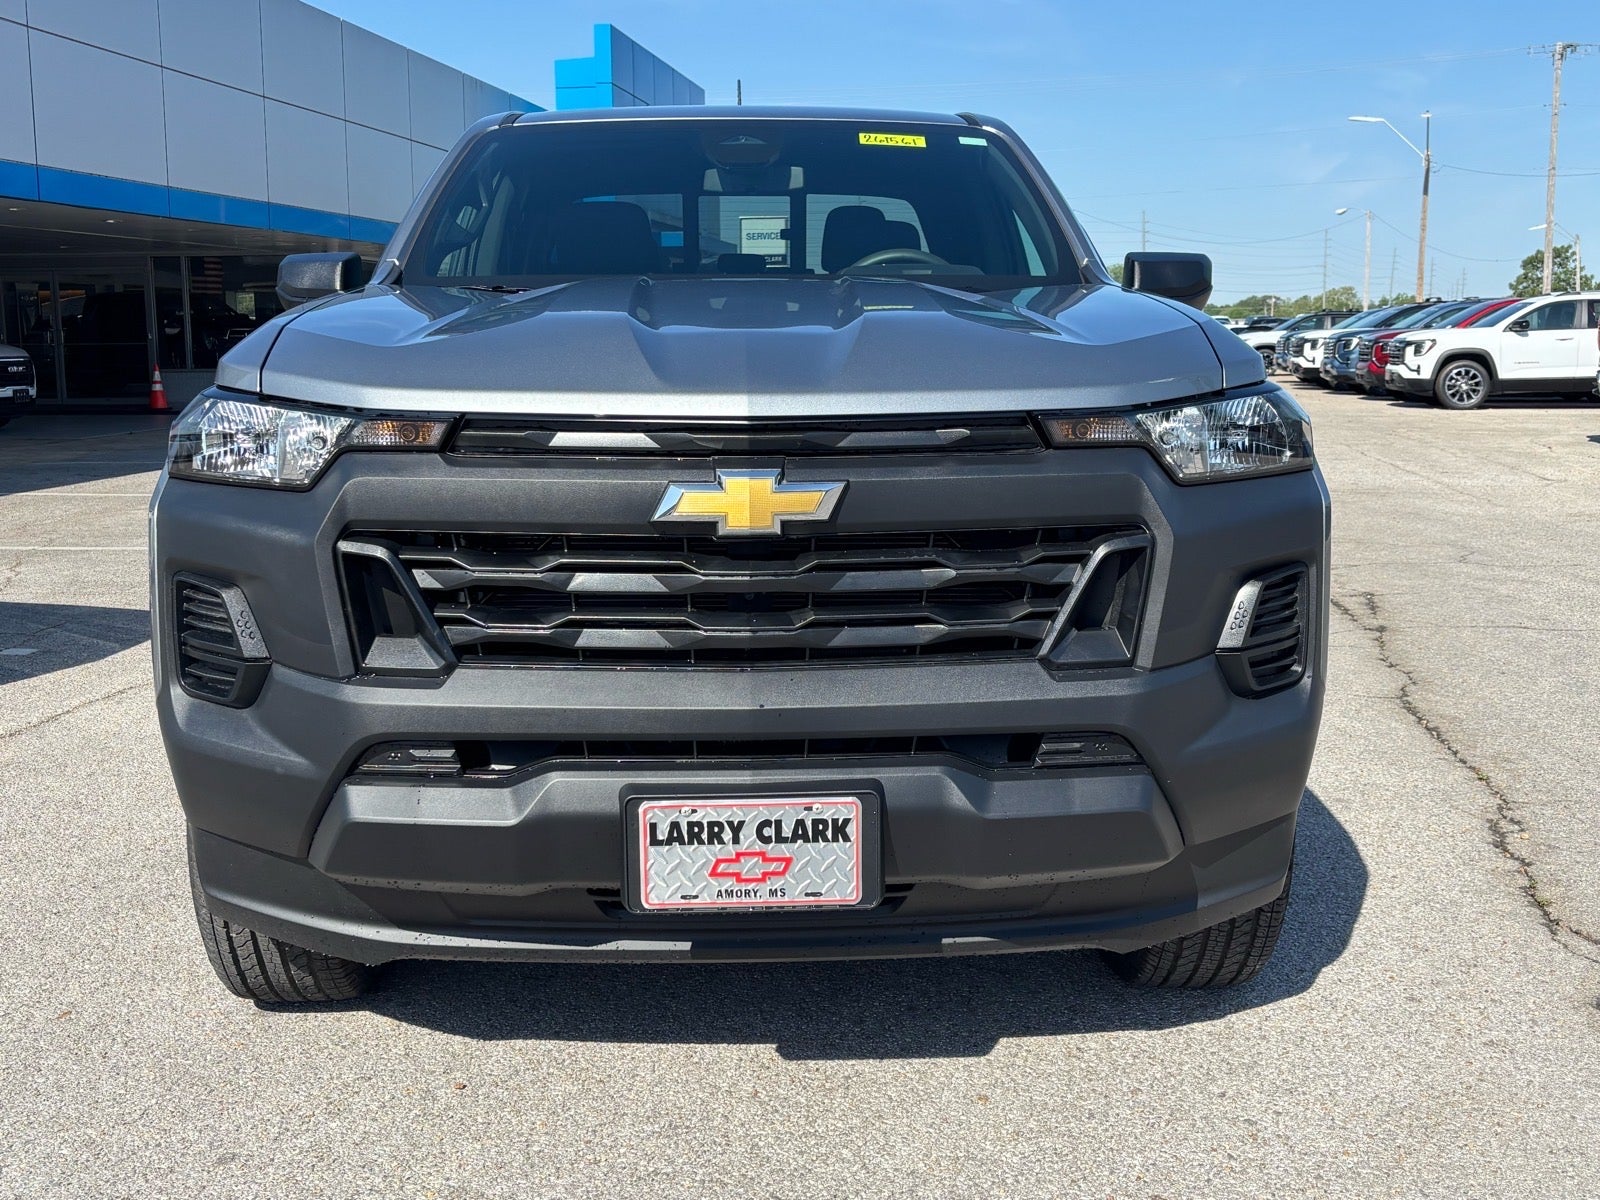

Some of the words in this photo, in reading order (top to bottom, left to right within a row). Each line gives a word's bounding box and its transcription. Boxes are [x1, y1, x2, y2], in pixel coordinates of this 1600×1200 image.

[745, 232, 780, 241] SERVICE
[649, 820, 746, 846] LARRY
[755, 818, 852, 844] CLARK
[716, 888, 762, 900] AMORY,
[768, 887, 786, 898] MS
